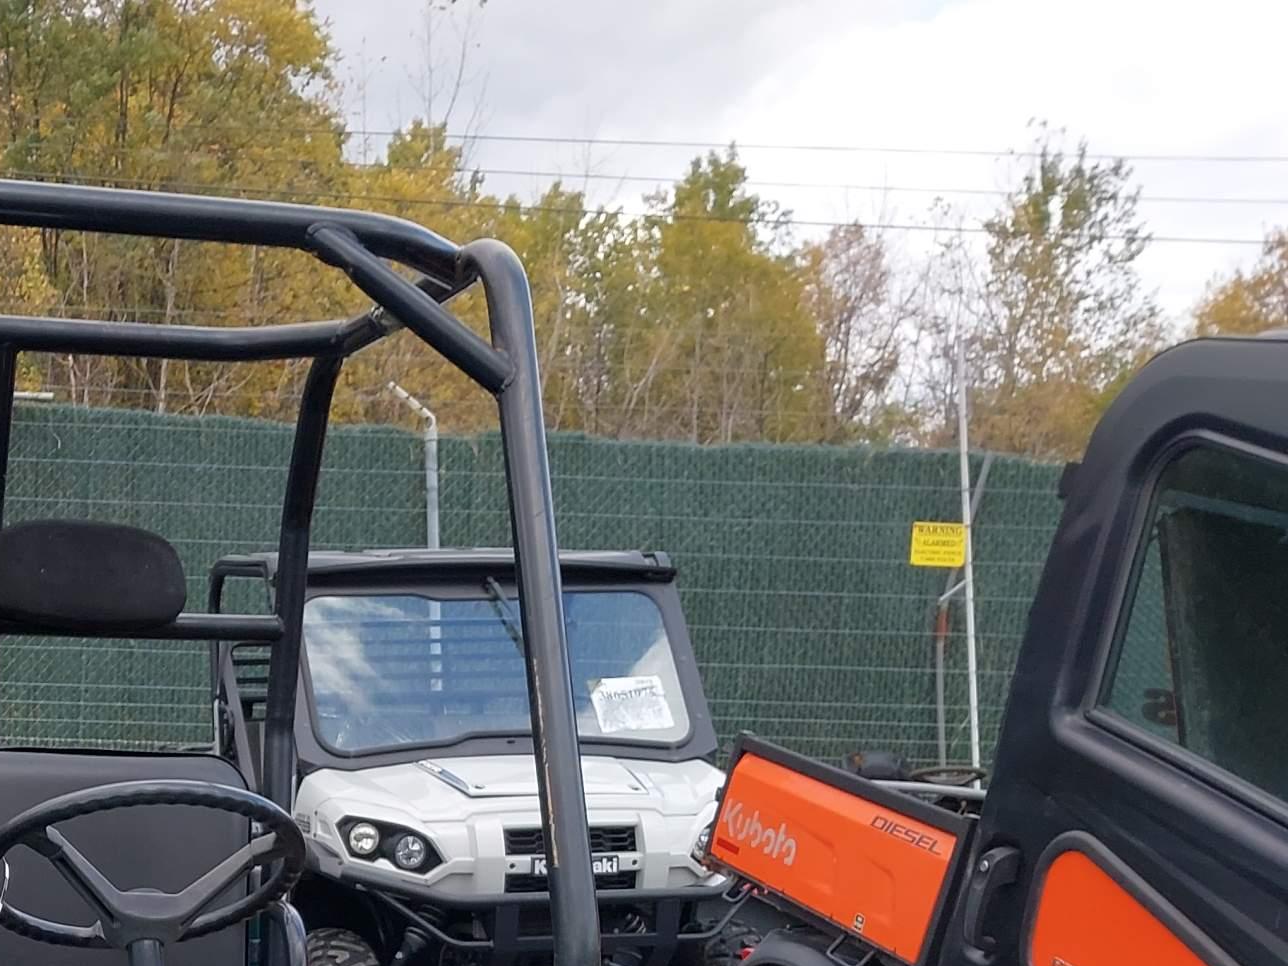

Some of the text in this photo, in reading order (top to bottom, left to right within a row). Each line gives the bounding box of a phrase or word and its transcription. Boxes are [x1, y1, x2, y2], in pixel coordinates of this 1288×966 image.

[918, 525, 962, 536] WARNING
[723, 798, 797, 866] Kubota
[870, 815, 942, 855] DIESEL
[534, 857, 618, 875] Kaki
